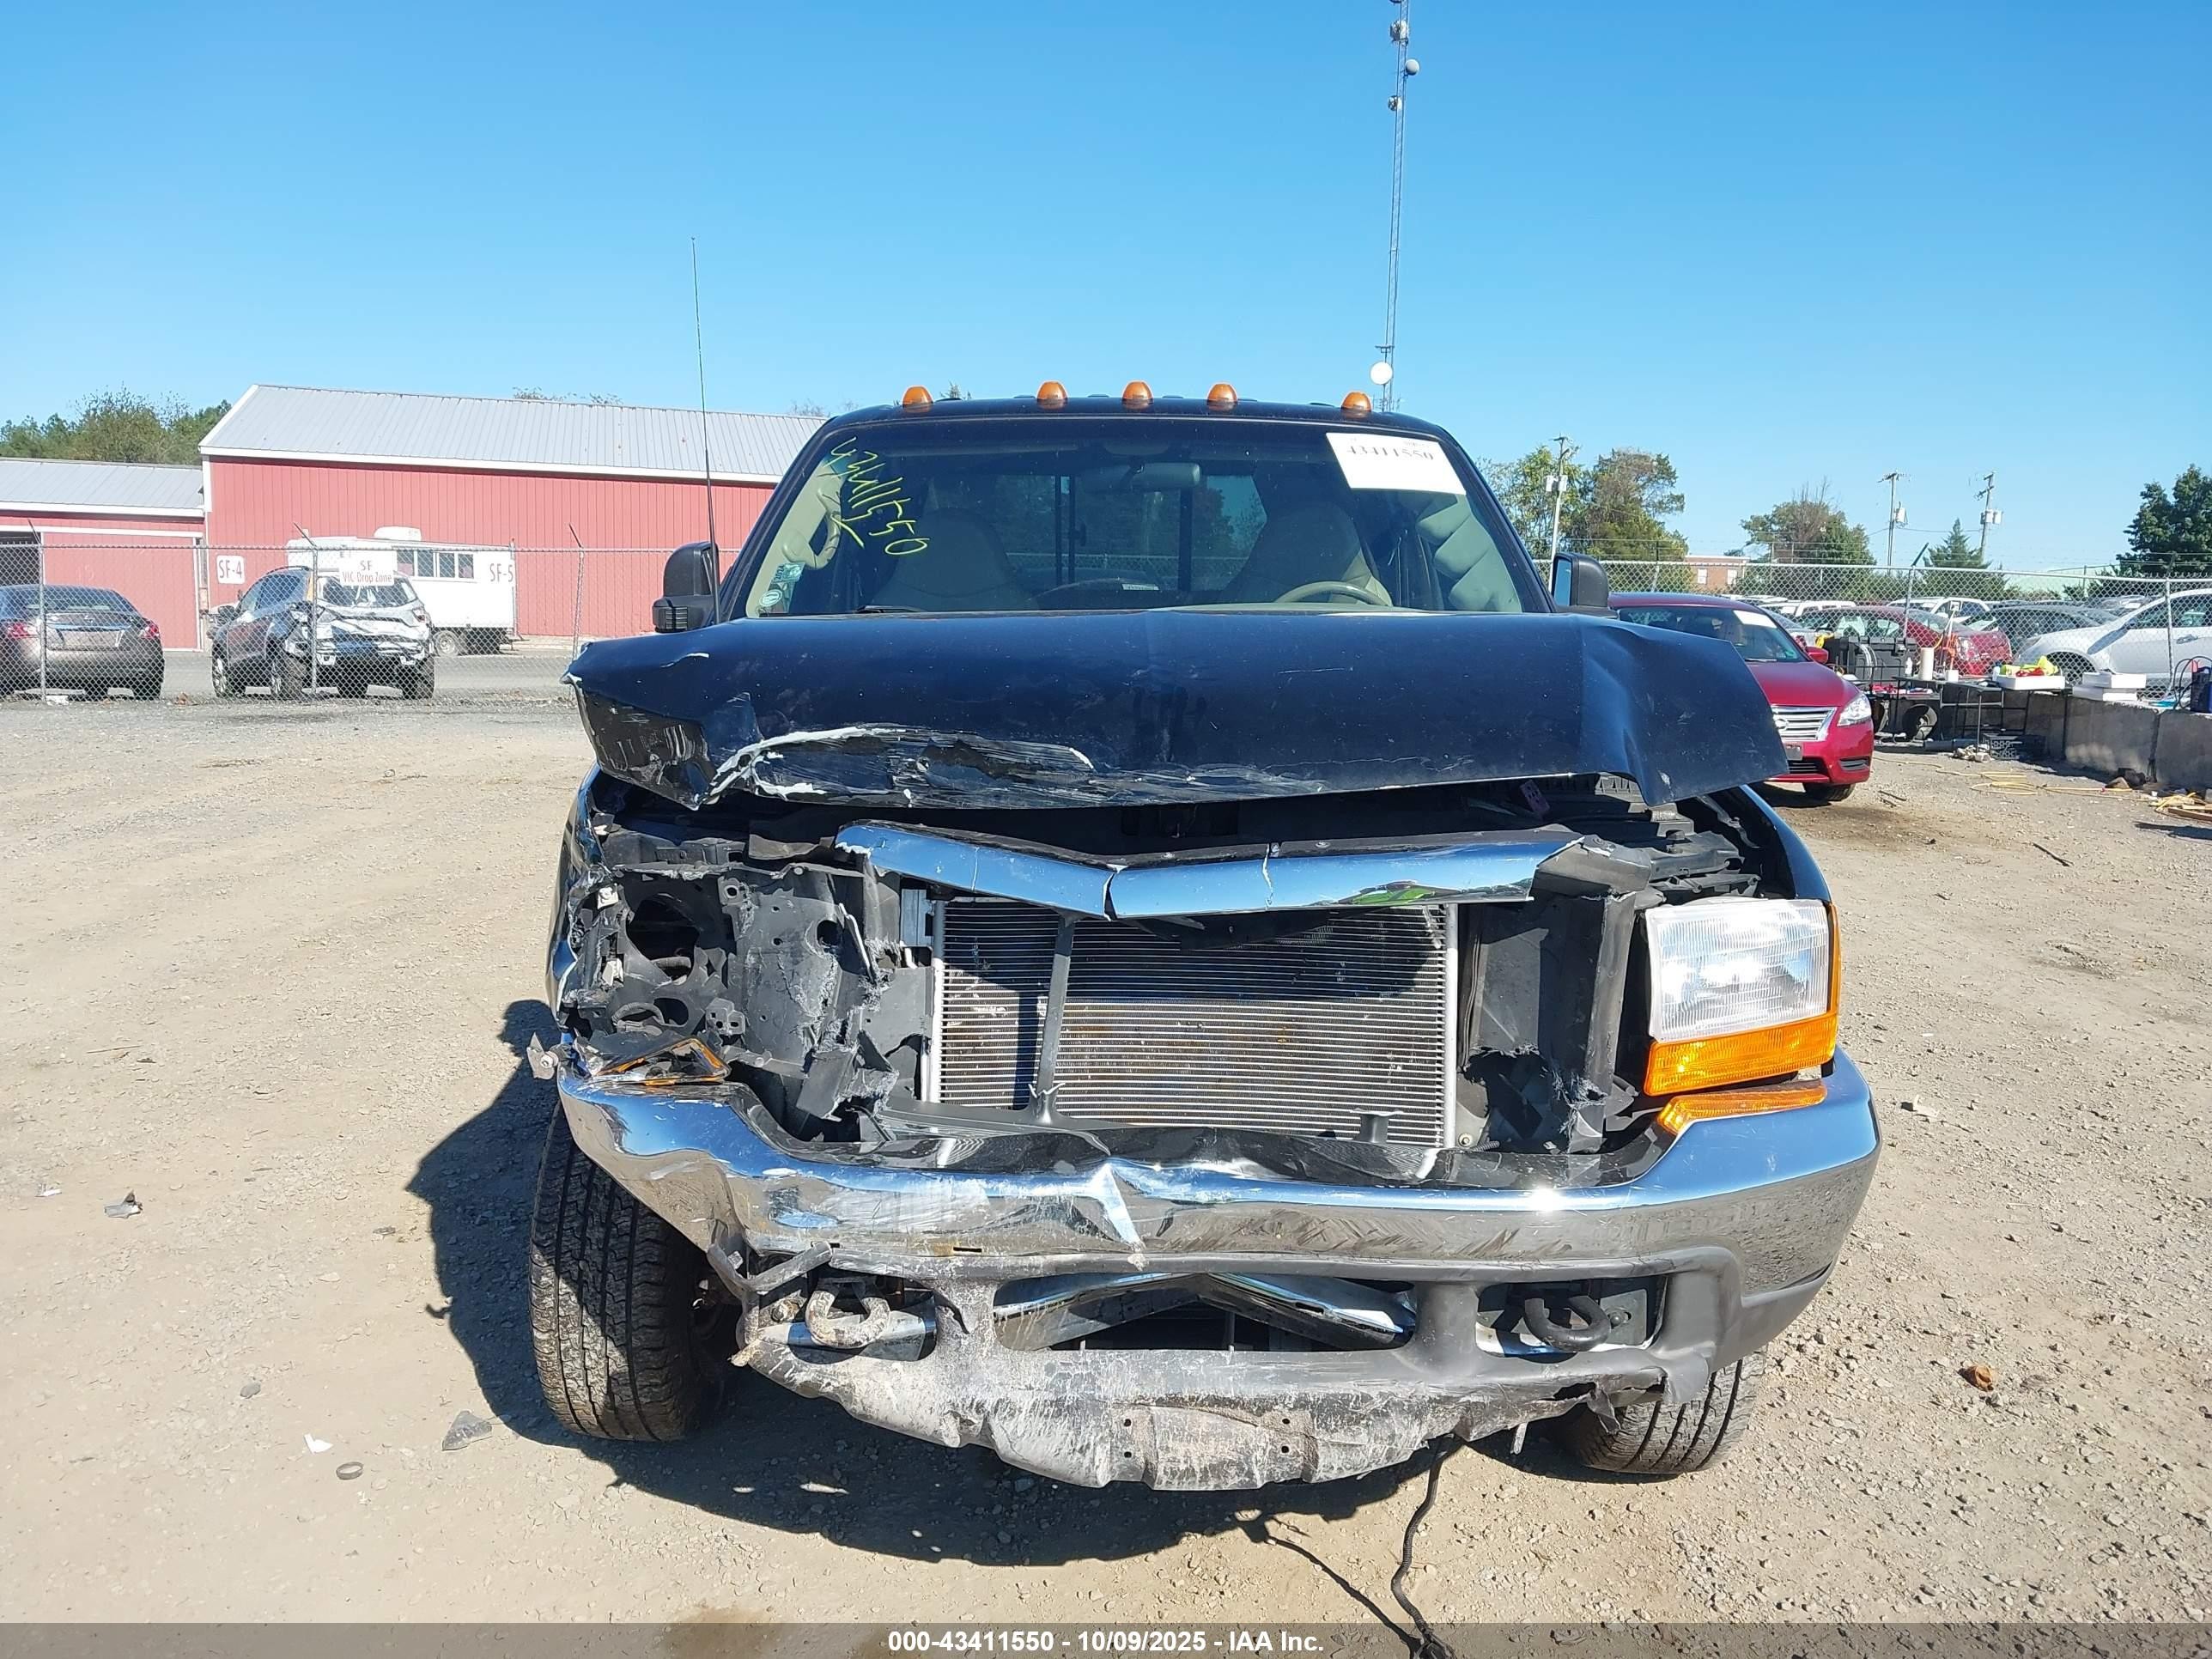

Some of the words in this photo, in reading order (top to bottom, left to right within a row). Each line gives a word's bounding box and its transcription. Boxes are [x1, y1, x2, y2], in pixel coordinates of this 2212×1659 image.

[218, 559, 242, 579] SF-4
[360, 560, 373, 571] SF
[489, 562, 514, 583] SF-5
[343, 571, 355, 582] VIC
[356, 571, 374, 584] Drop
[375, 571, 392, 582] Zone
